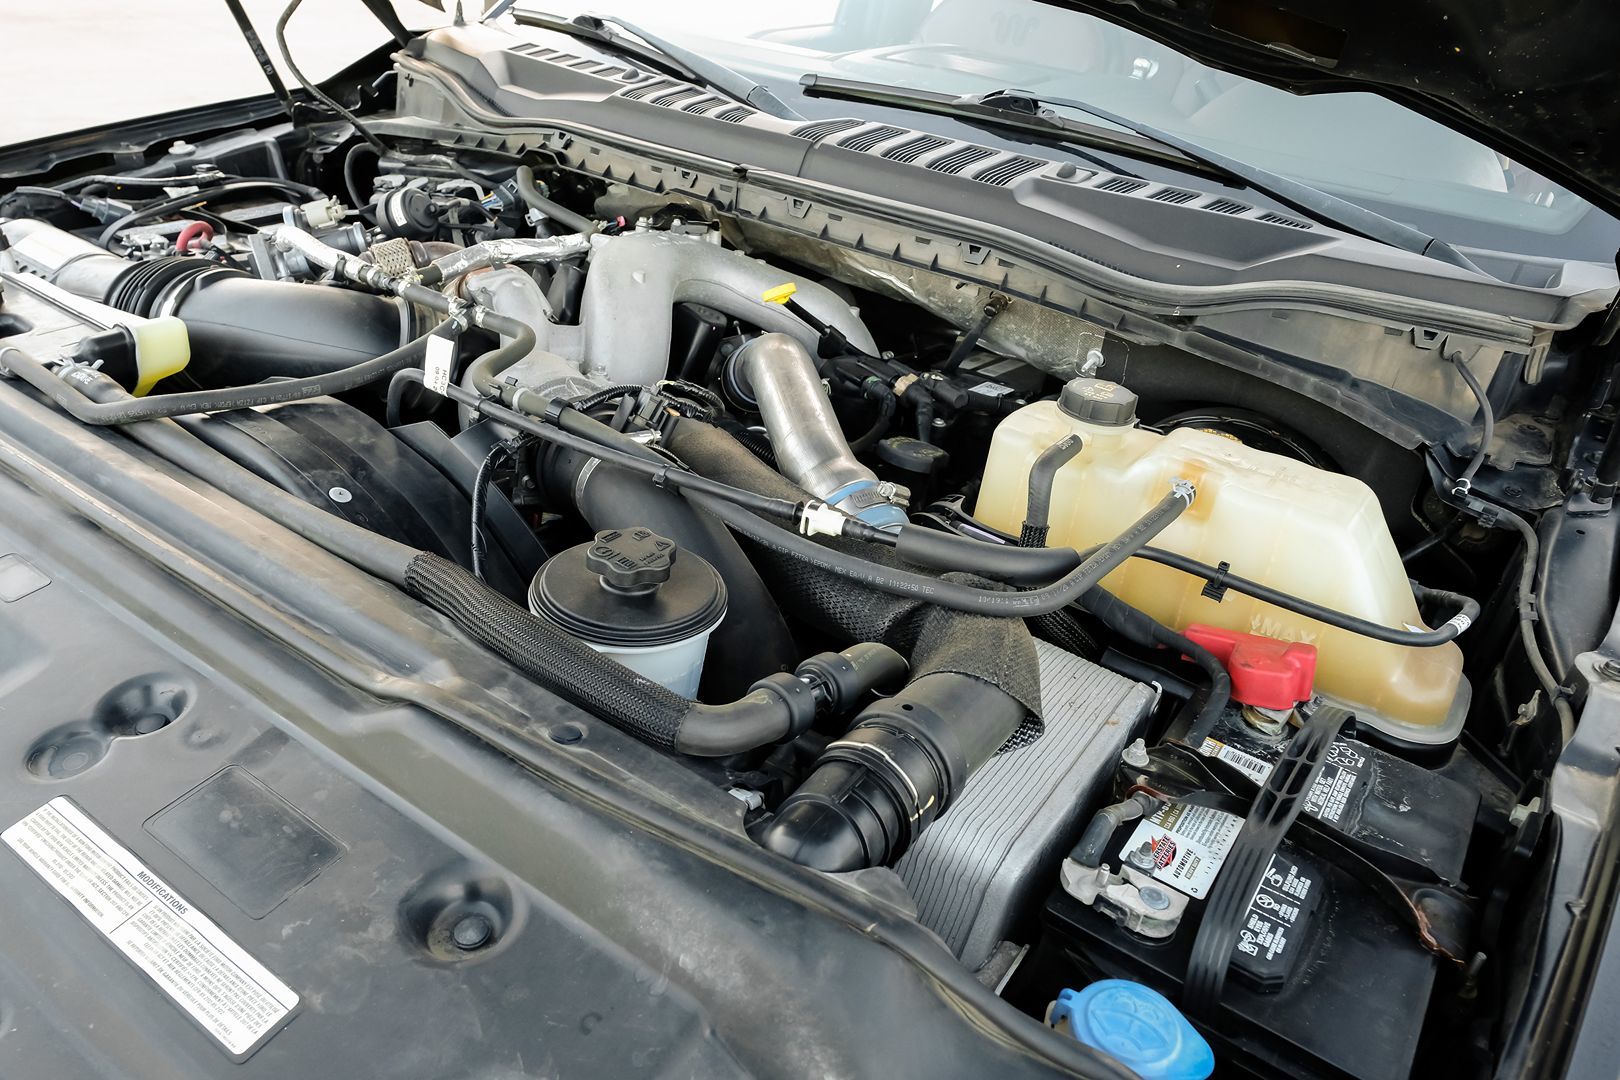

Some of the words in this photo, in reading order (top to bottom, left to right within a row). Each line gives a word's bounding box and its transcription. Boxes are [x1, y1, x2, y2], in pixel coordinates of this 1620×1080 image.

[1156, 840, 1177, 870] BATTERIES
[1173, 849, 1193, 878] AUTOMOTIVE
[137, 871, 188, 915] MODIFICATIONS
